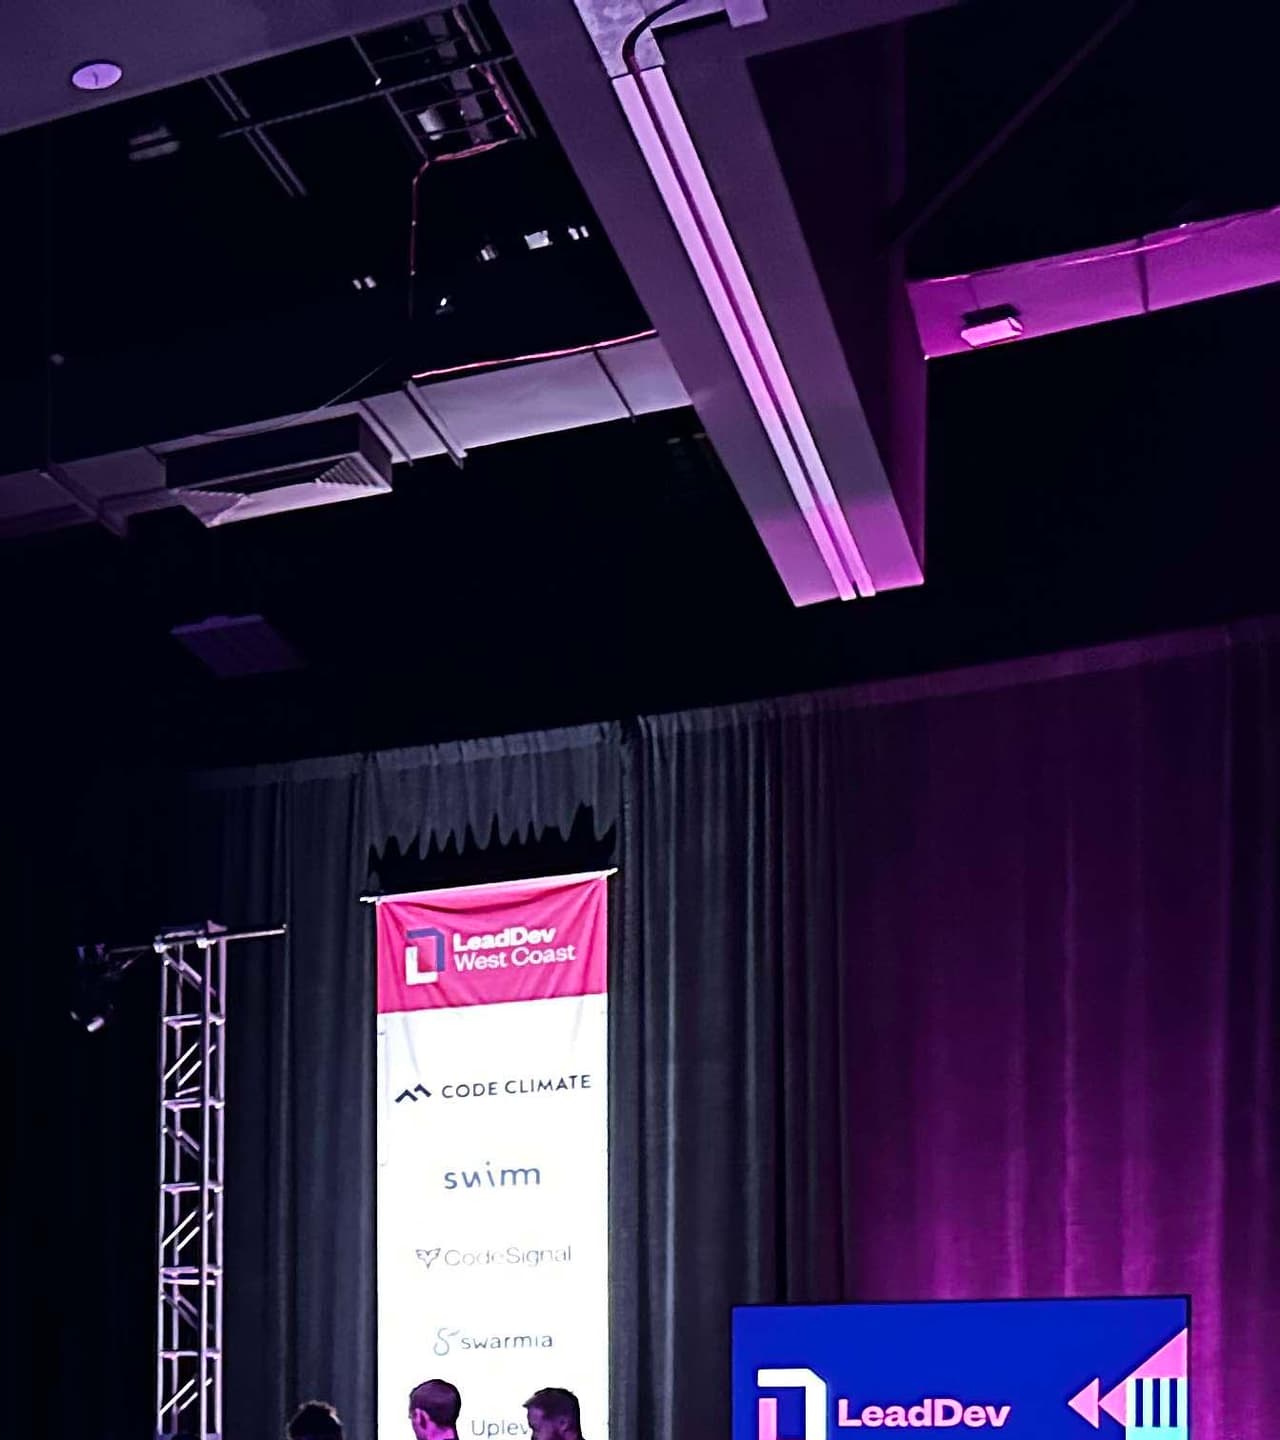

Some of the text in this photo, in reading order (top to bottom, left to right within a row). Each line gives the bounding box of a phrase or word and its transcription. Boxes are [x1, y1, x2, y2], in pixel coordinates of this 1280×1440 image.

[452, 926, 557, 952] LeadDev
[454, 944, 576, 972] West Coast
[442, 1074, 592, 1099] CODE CLIMATE
[461, 1335, 553, 1350] swarmia
[837, 1398, 1011, 1428] LeadDev
[471, 1419, 528, 1439] Uplev
